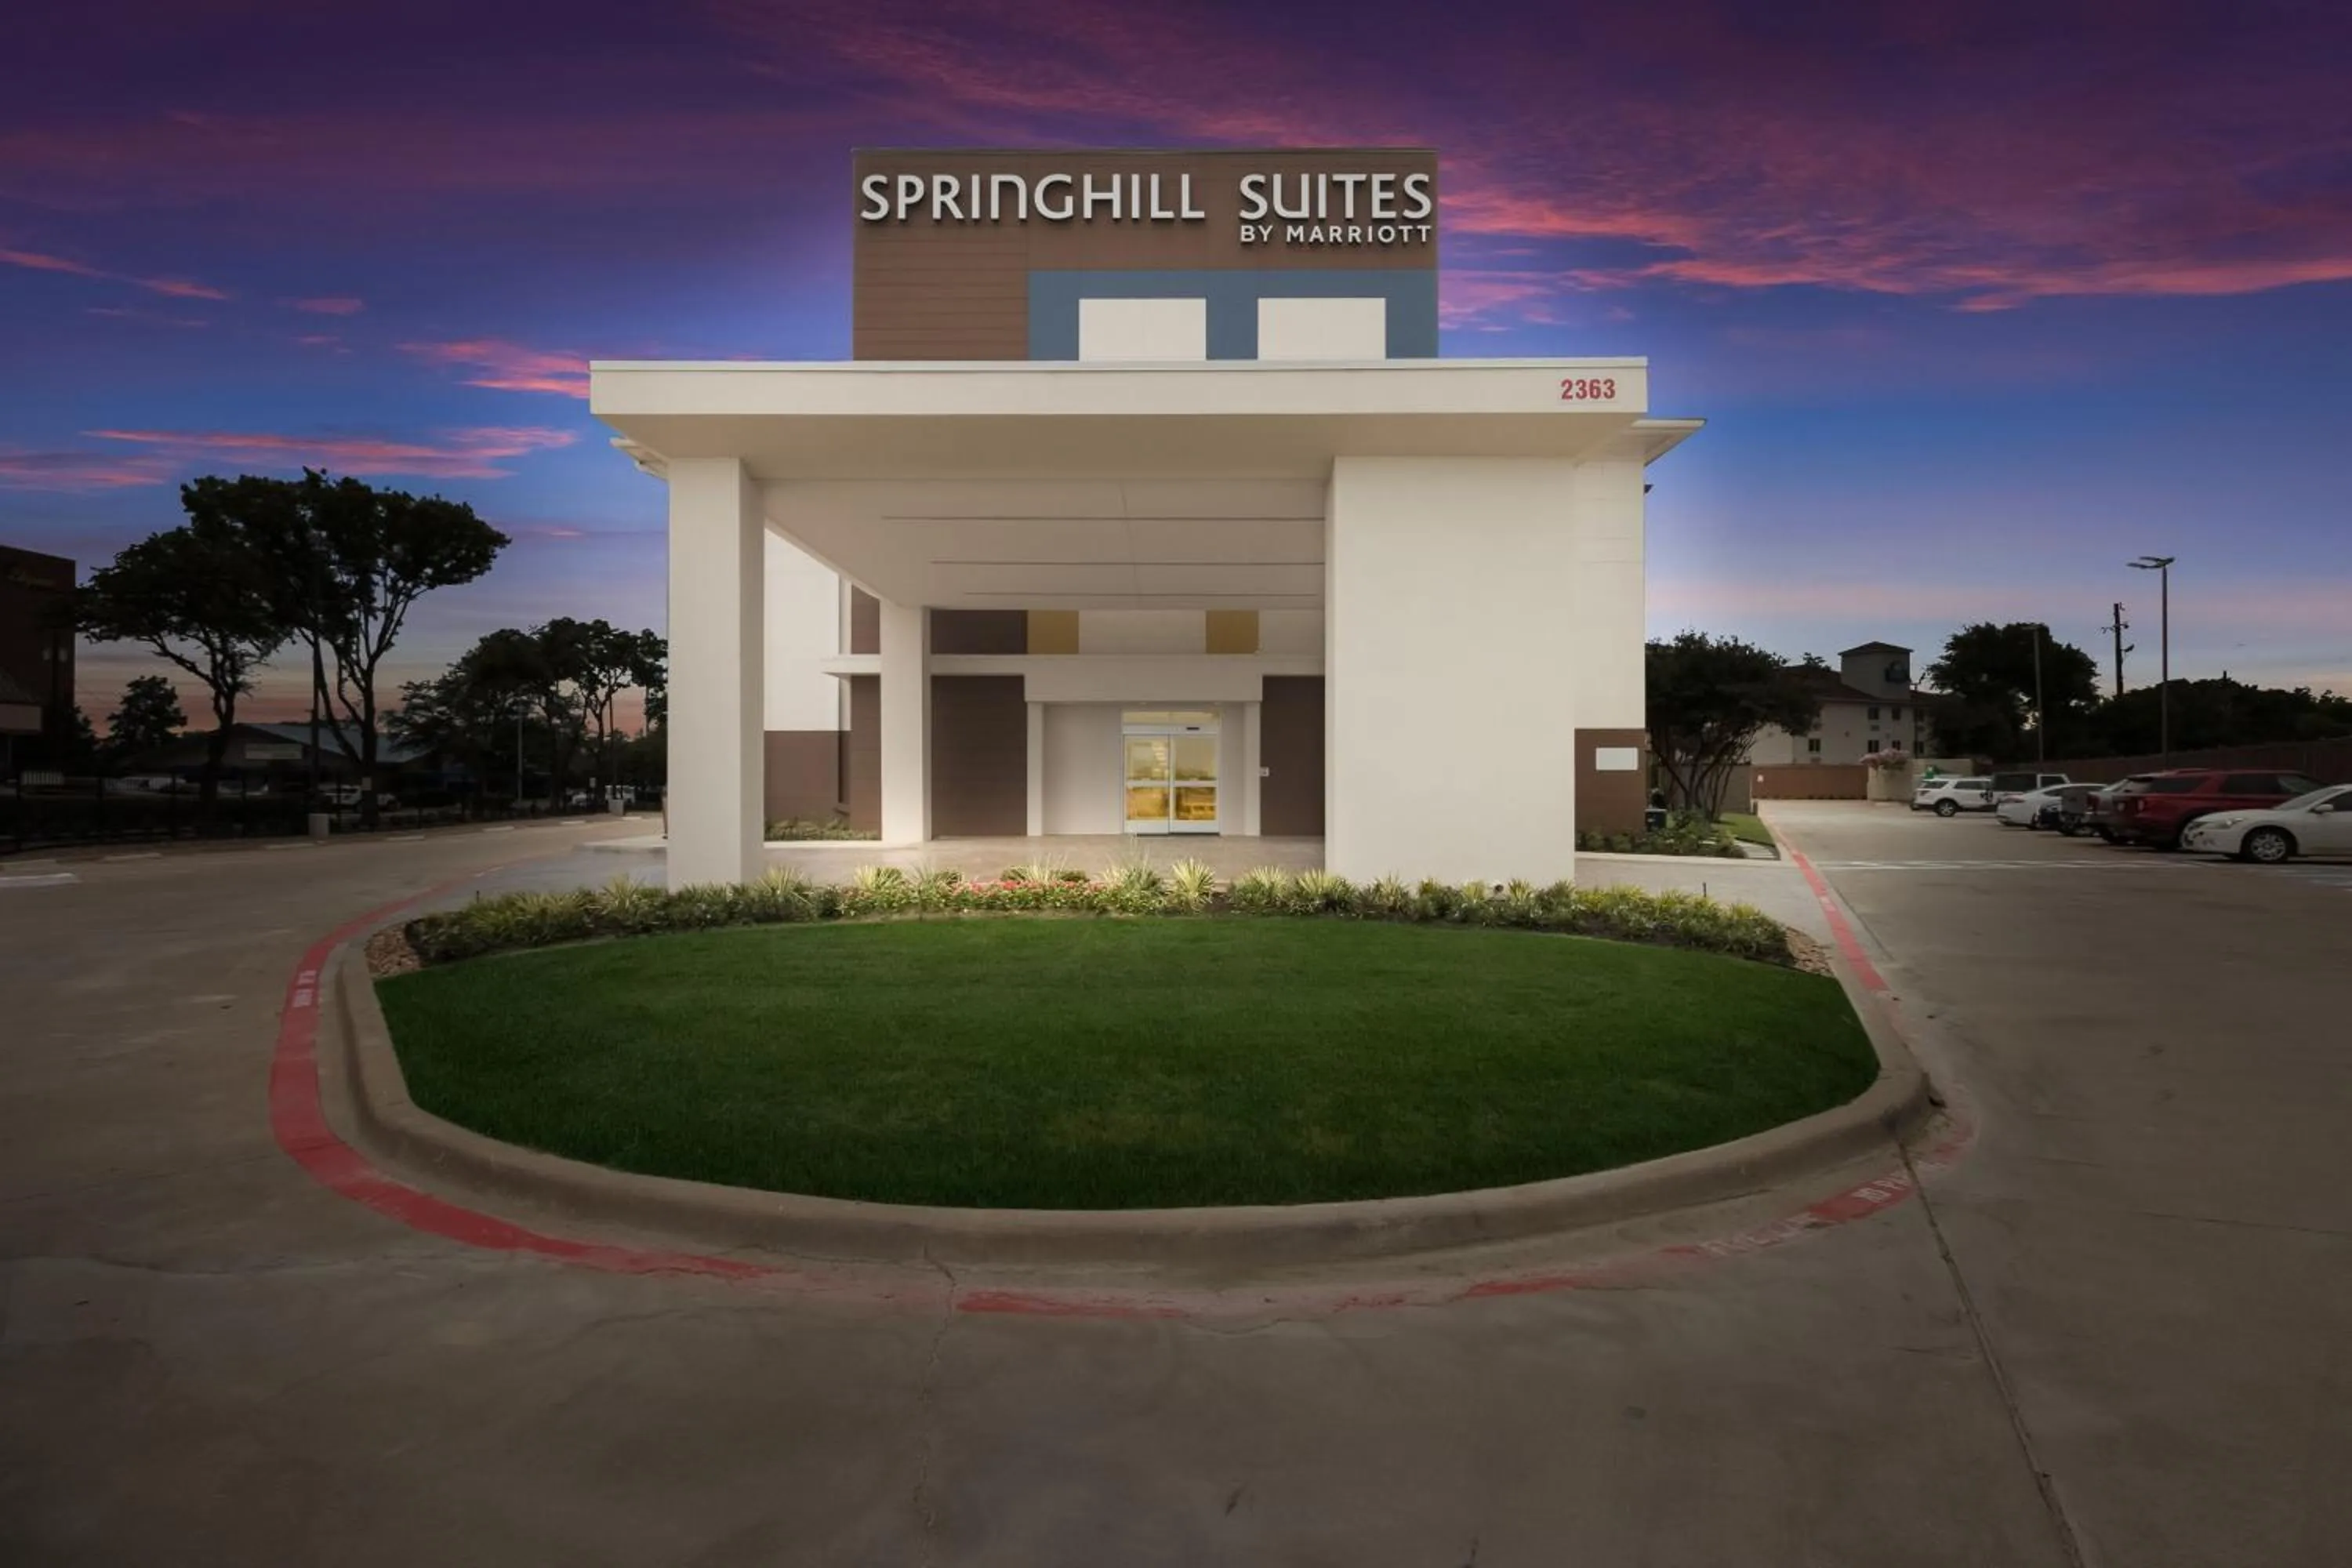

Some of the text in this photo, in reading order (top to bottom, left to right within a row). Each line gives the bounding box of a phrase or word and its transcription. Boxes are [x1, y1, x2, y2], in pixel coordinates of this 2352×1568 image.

[860, 173, 1432, 220] SPRINGHILL SUITES
[1240, 225, 1432, 243] BY MARRIOTT
[1561, 378, 1616, 400] 2363
